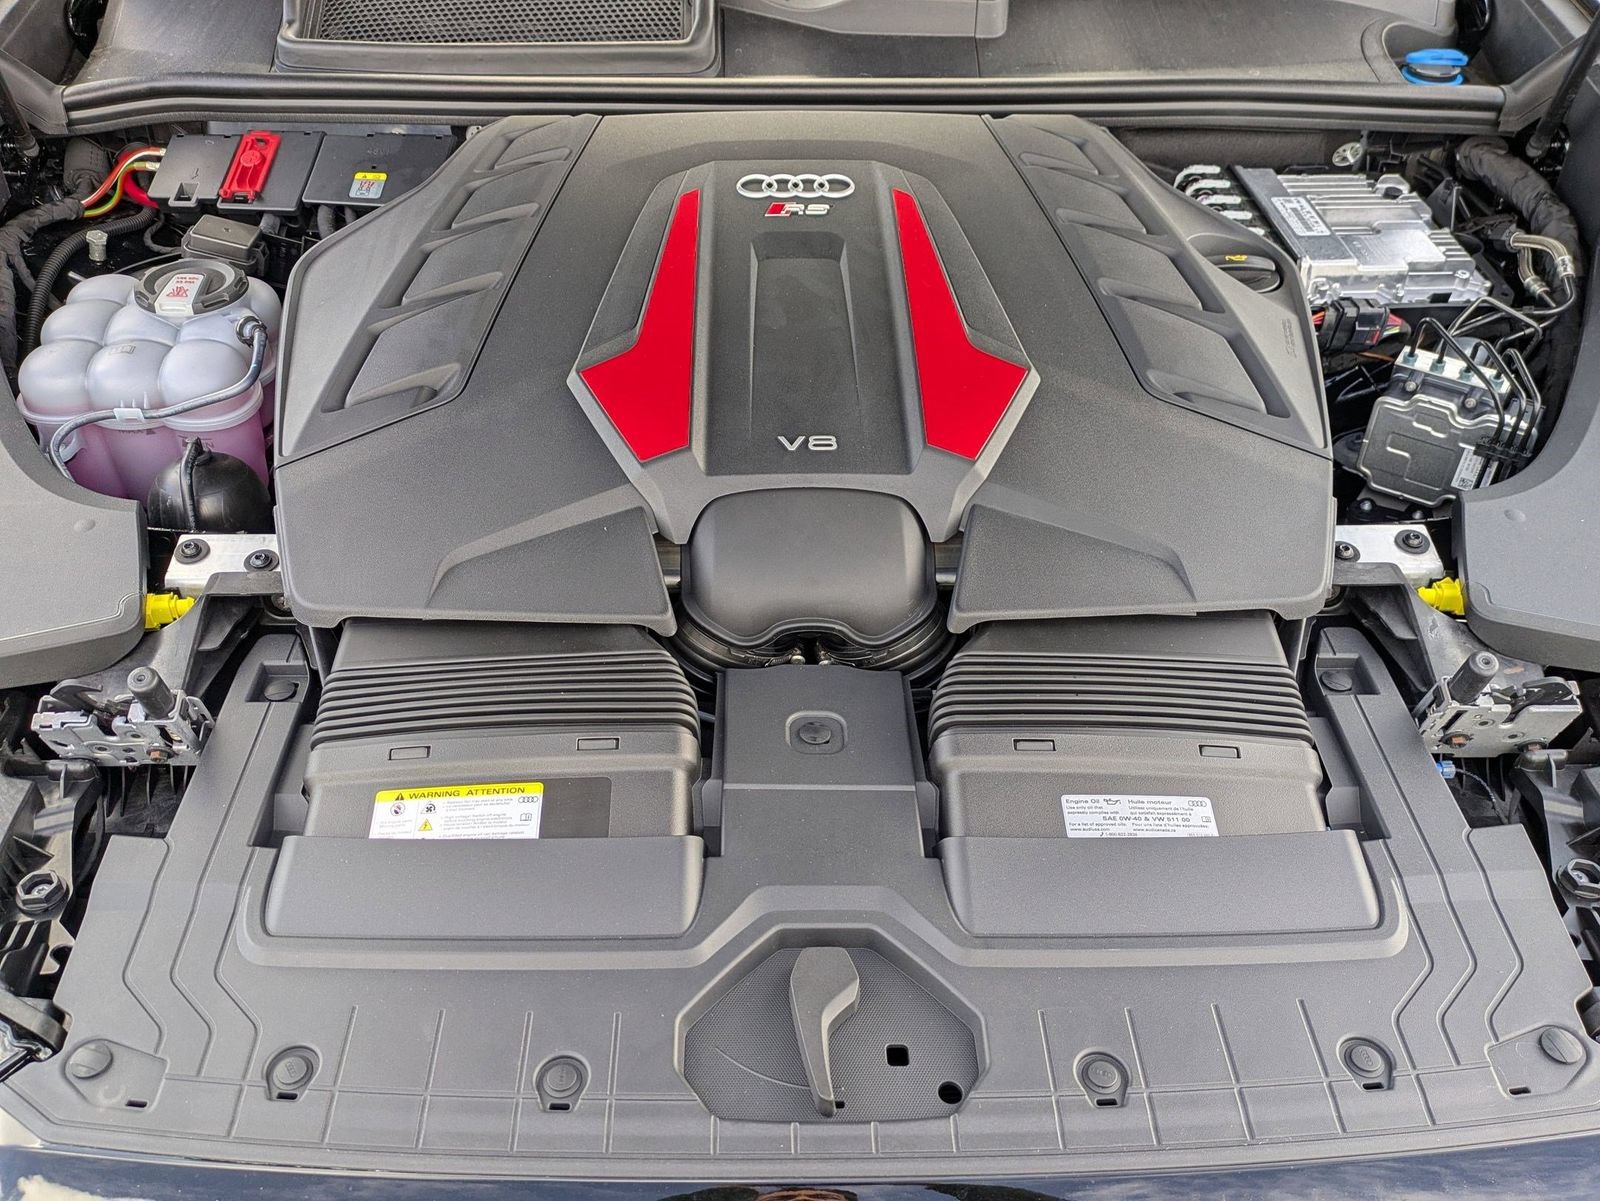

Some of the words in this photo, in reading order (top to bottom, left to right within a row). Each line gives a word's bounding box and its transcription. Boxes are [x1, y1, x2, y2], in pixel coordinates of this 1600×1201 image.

[766, 202, 832, 217] RS
[777, 435, 838, 451] V8
[409, 790, 460, 799] WARNING
[466, 787, 526, 796] ATTENTION
